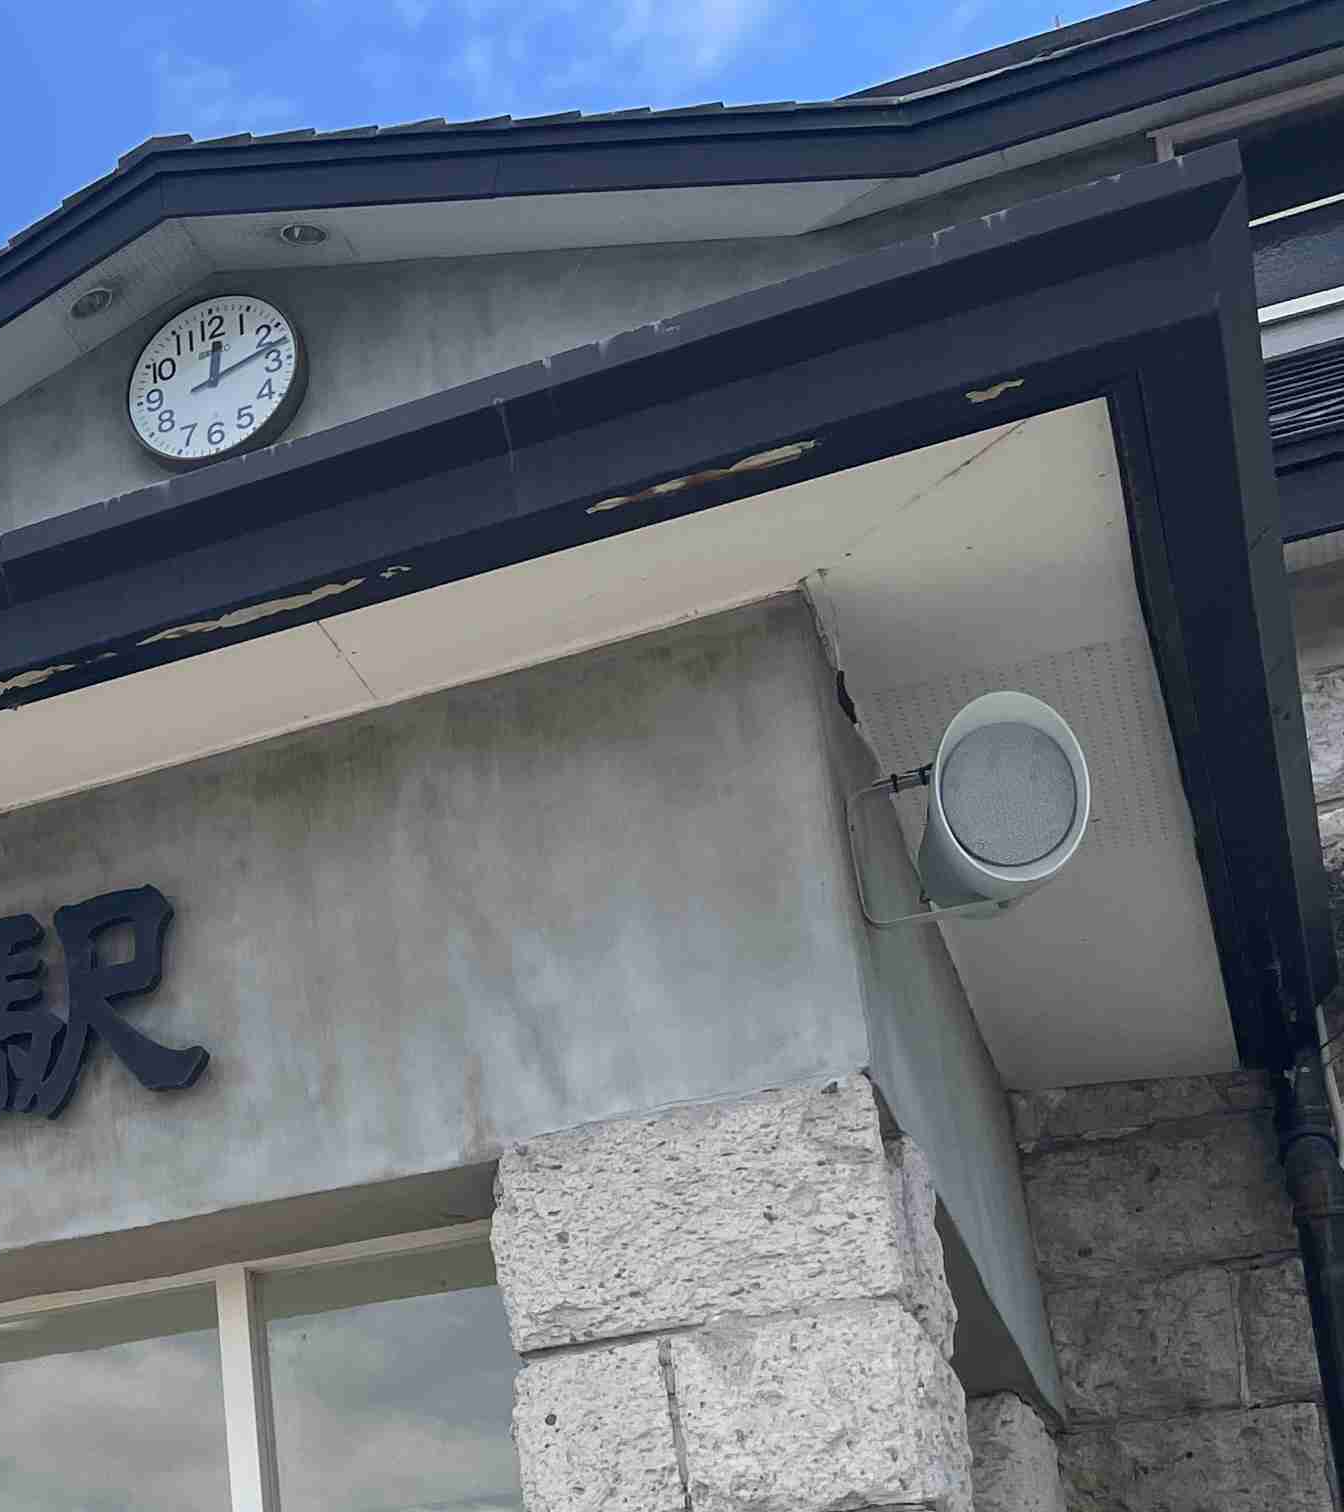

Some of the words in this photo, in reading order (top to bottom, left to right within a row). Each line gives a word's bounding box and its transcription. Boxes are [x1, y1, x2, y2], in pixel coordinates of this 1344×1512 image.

[199, 314, 226, 342] 12
[239, 313, 245, 335] 1
[176, 331, 194, 356] 11
[255, 324, 275, 349] 2
[152, 358, 176, 384] 10
[265, 349, 282, 373] 3
[146, 388, 163, 412] 9
[256, 377, 277, 401] 4
[158, 408, 176, 433] 8
[237, 405, 254, 429] 5
[180, 422, 199, 448] 7
[207, 422, 225, 446] 6
